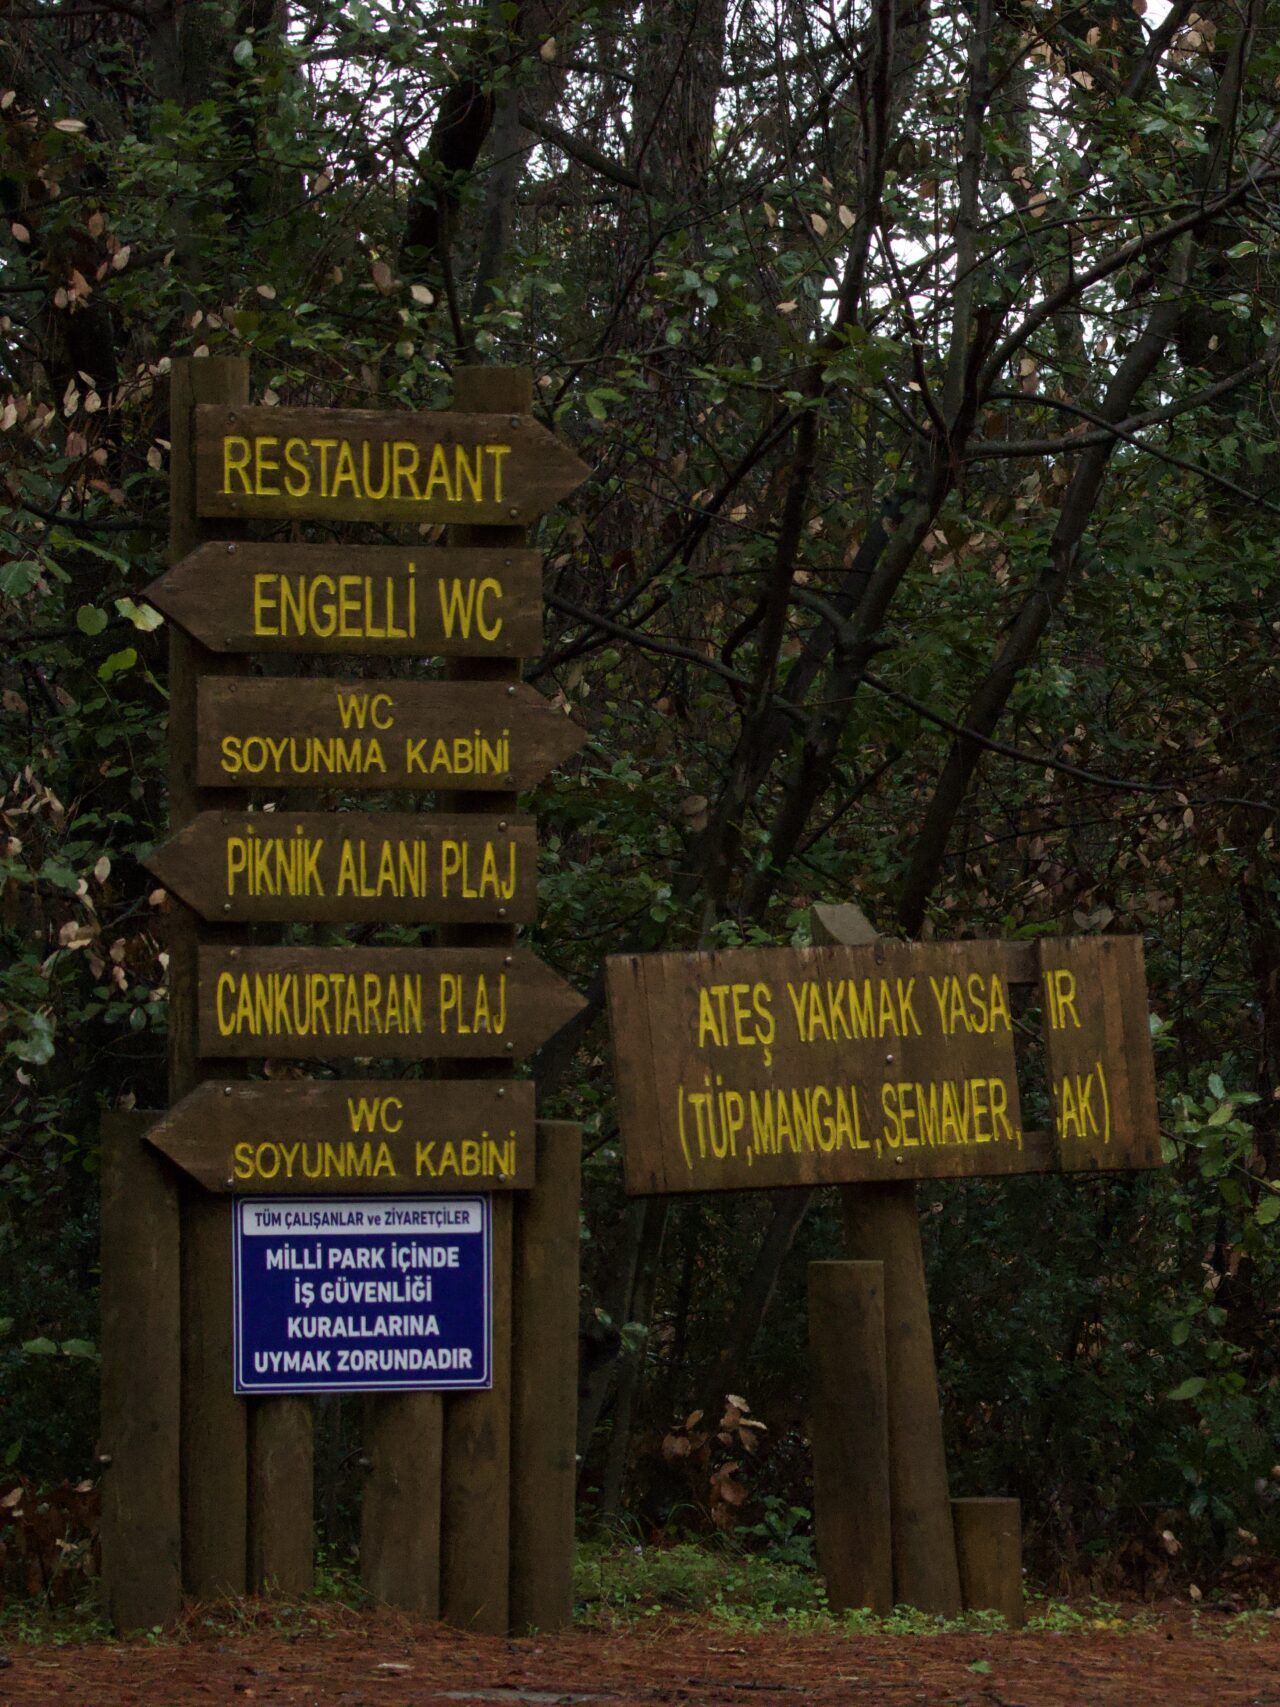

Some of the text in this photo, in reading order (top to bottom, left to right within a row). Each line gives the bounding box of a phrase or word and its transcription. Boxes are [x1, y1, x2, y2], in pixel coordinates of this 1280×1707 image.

[223, 436, 511, 503] RESTAURANT
[253, 561, 503, 641] ENGELLİ WC
[337, 692, 394, 730] WC
[220, 729, 510, 776] SOYUNMA KABİNİ
[226, 825, 517, 899] PİKNİK ALANI PLAJ
[216, 971, 506, 1037] CANKURTARAN PLAJ
[698, 983, 776, 1067] ATEŞ
[786, 978, 923, 1041] YAKMAK
[347, 1096, 403, 1134] WC
[233, 1130, 516, 1180] SOYUNMA KABİNİ
[254, 1204, 470, 1230] TÜM ÇALIŞANLAR ve ZİYARETÇİLER
[266, 1241, 460, 1273] MİLLİ PARK İÇİNDE
[294, 1275, 432, 1309] İŞ GÜVENLİĞİ
[287, 1314, 440, 1338] KURALLARINA
[254, 1347, 473, 1373] UYMAK ZORUNDADIR
